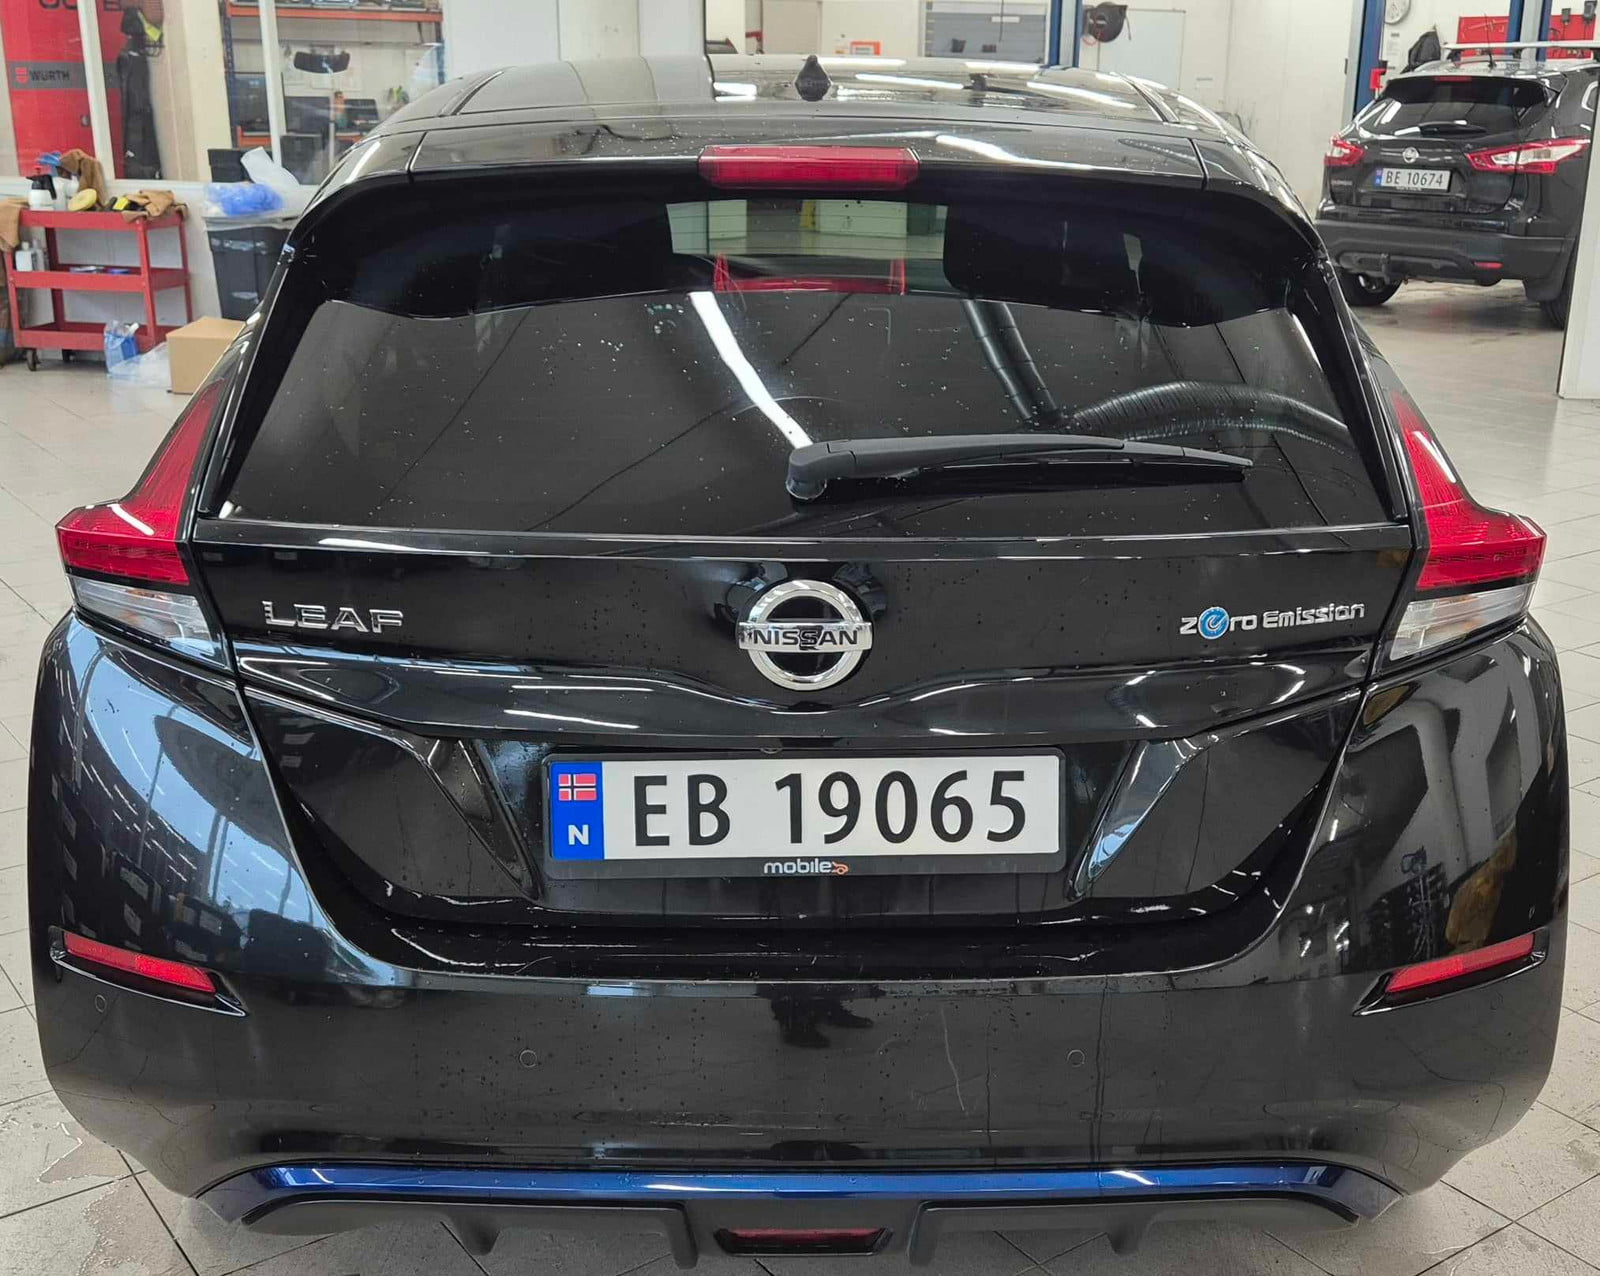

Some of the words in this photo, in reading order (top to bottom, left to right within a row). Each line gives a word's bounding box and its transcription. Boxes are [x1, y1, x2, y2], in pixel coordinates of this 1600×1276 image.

[1385, 170, 1401, 185] BE
[1407, 171, 1443, 187] 10674
[262, 600, 404, 634] LEAF
[1262, 603, 1365, 628] Emission
[753, 630, 858, 646] NISSAN
[633, 773, 731, 847] EB
[774, 769, 1027, 845] 19065
[567, 823, 590, 846] N
[763, 858, 833, 875] mobile
